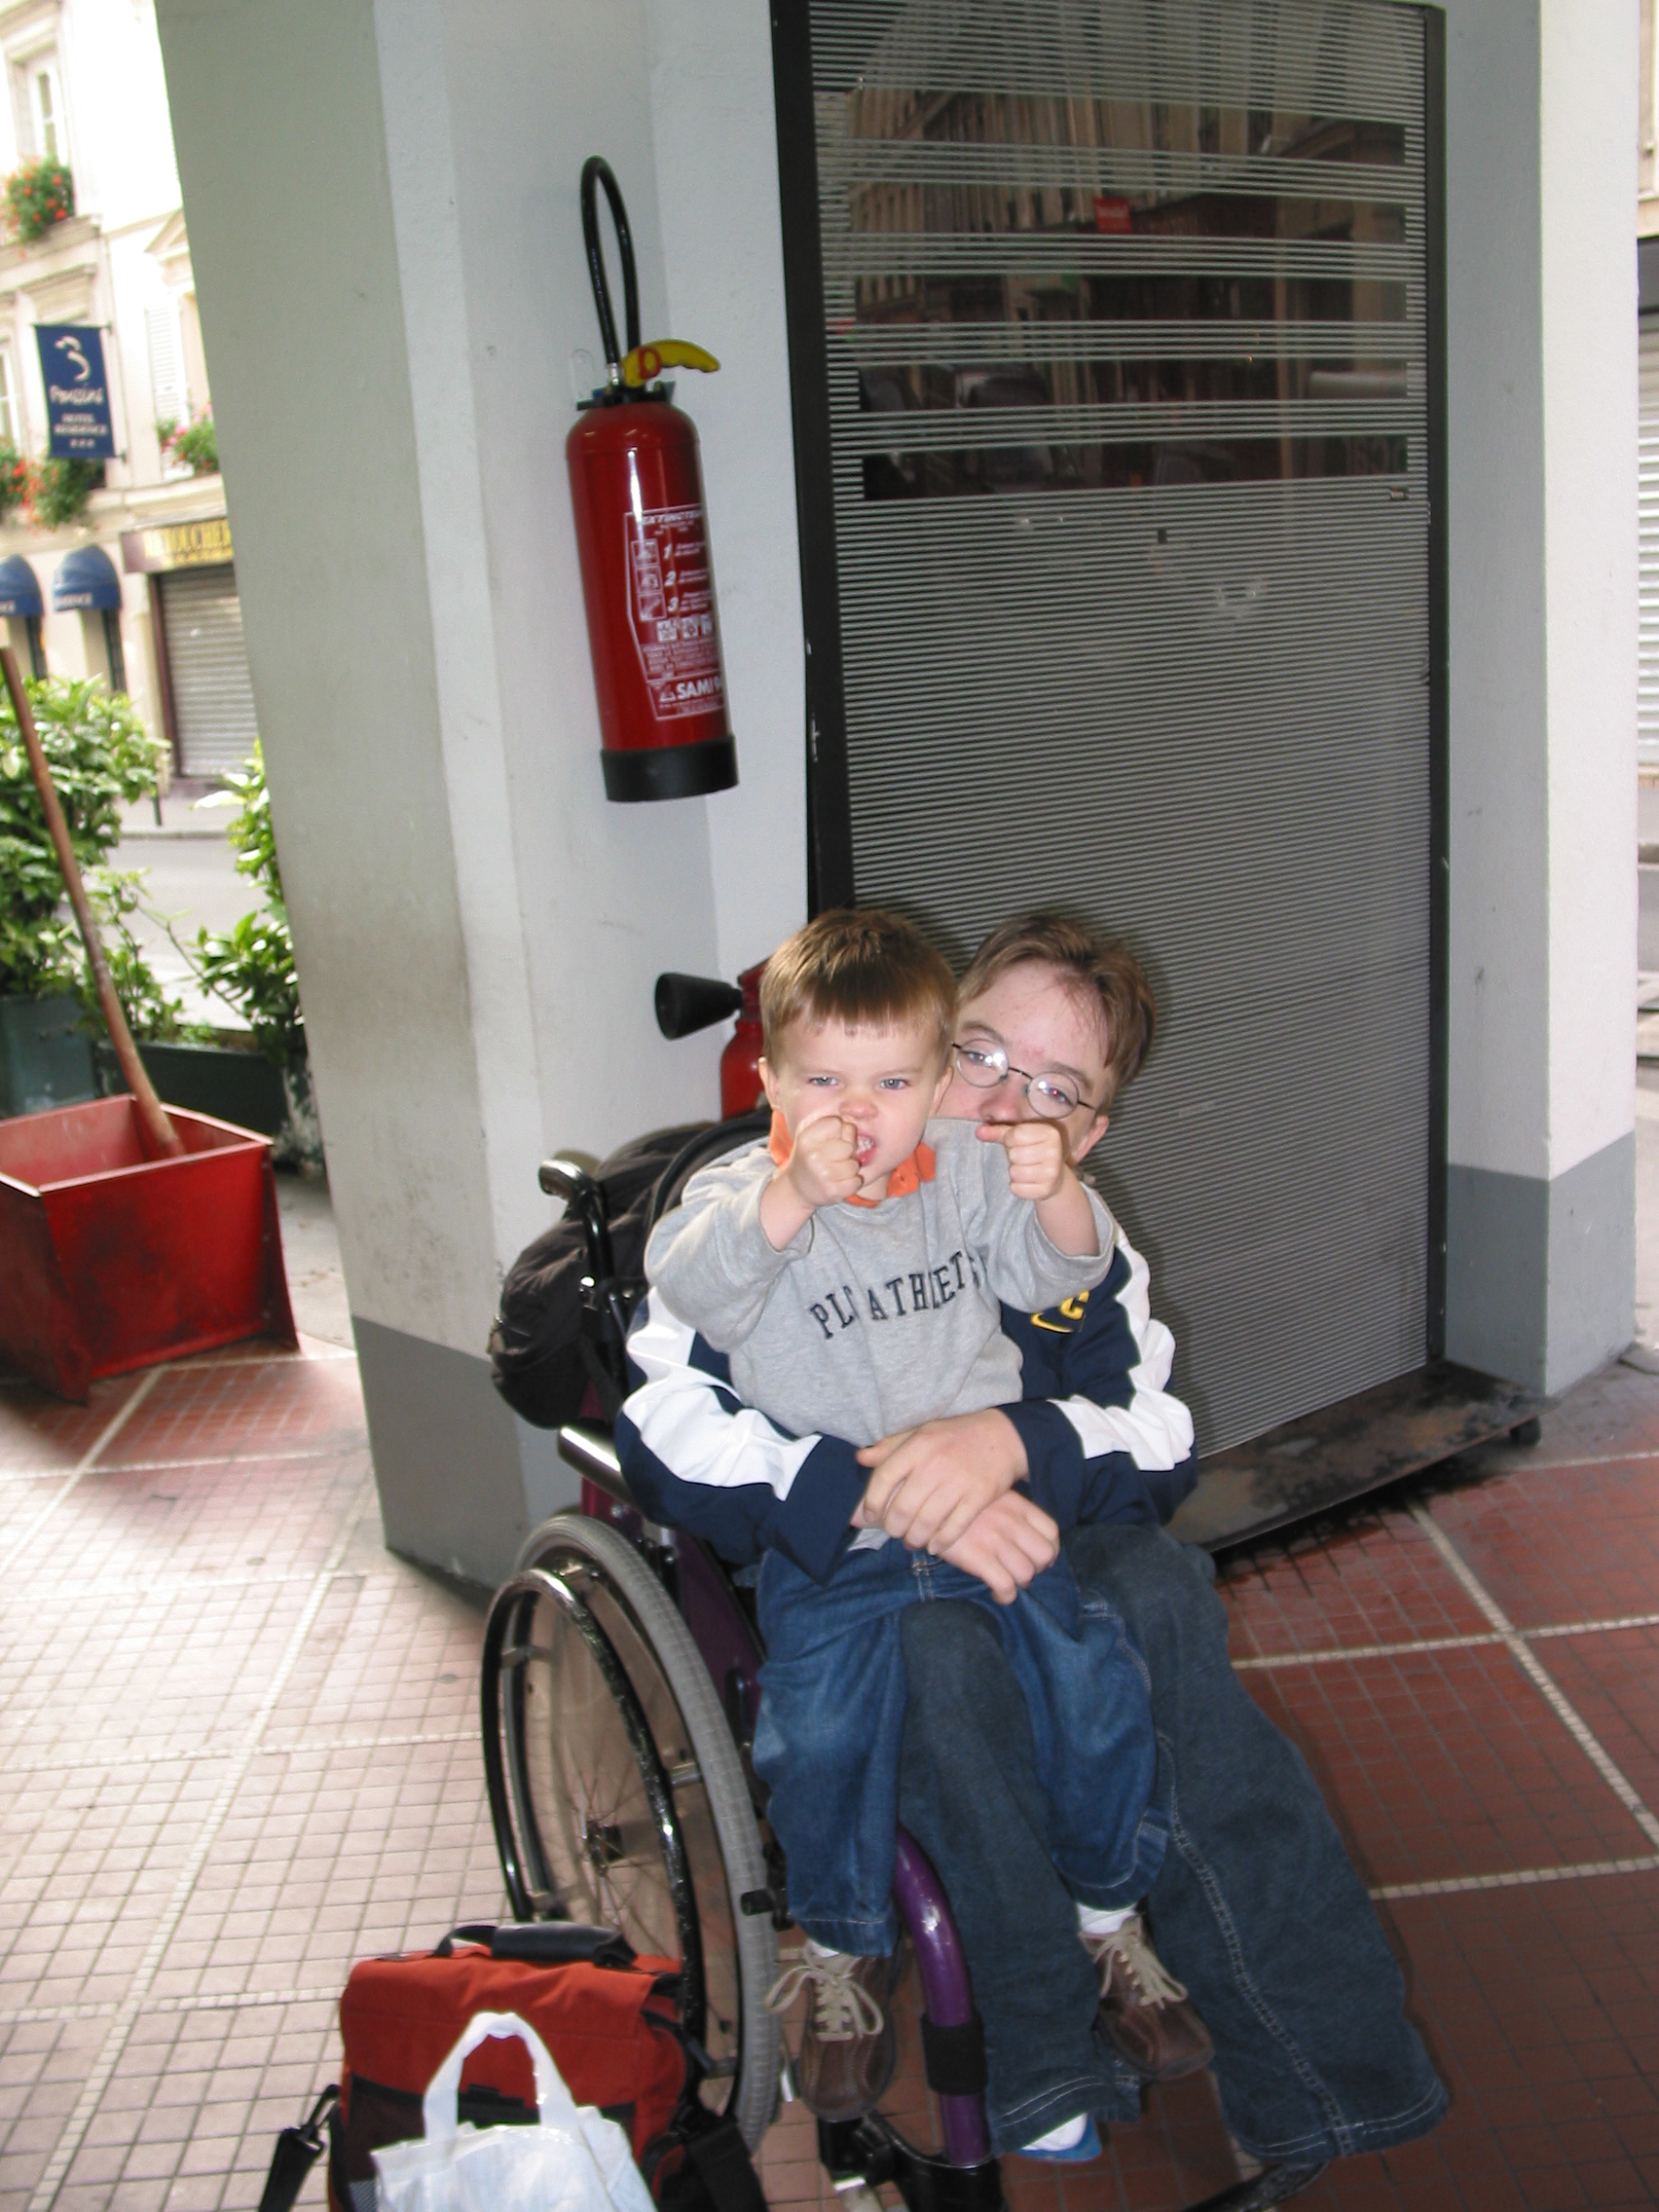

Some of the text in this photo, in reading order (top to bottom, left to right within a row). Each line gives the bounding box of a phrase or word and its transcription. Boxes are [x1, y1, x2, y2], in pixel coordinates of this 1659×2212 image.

[663, 542, 673, 560] 1
[664, 570, 677, 587] 2
[667, 595, 680, 612] 3
